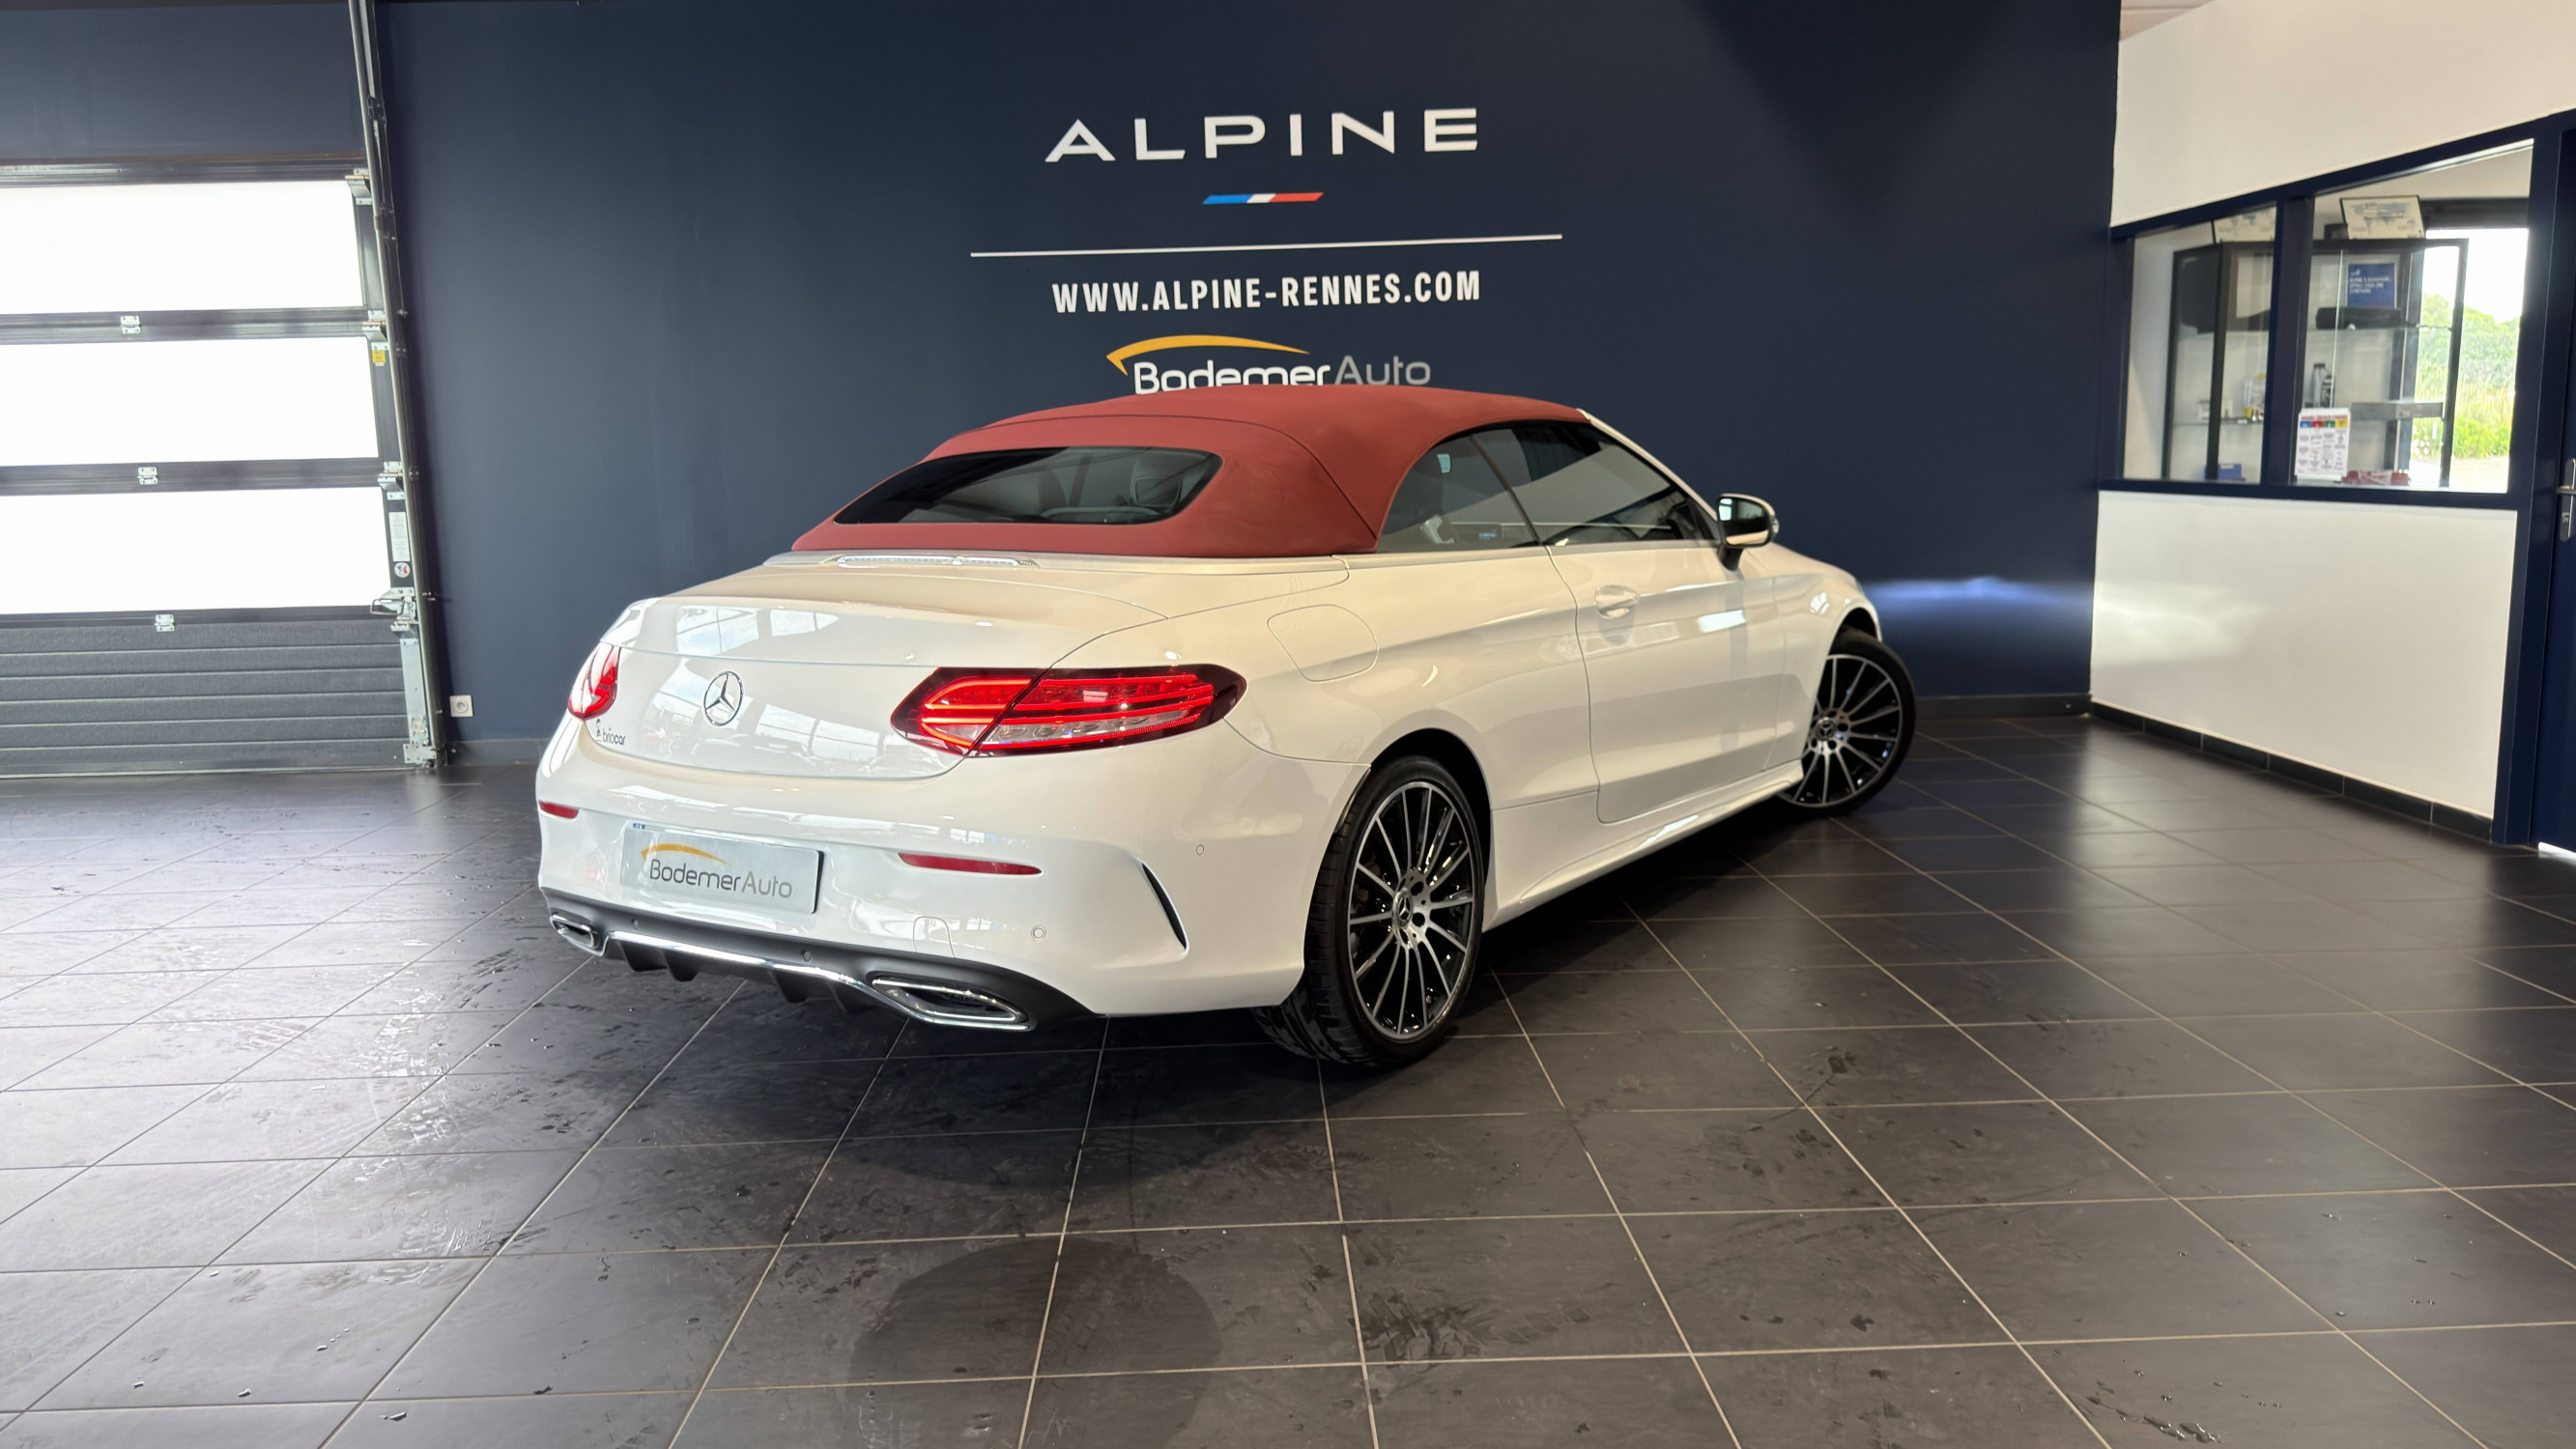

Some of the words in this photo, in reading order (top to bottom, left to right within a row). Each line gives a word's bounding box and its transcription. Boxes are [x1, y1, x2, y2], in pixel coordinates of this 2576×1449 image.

[1045, 107, 1478, 162] ALPINE
[1051, 270, 1480, 313] WWW.ALPINE-RENNES.COM
[602, 726, 626, 745] briocar
